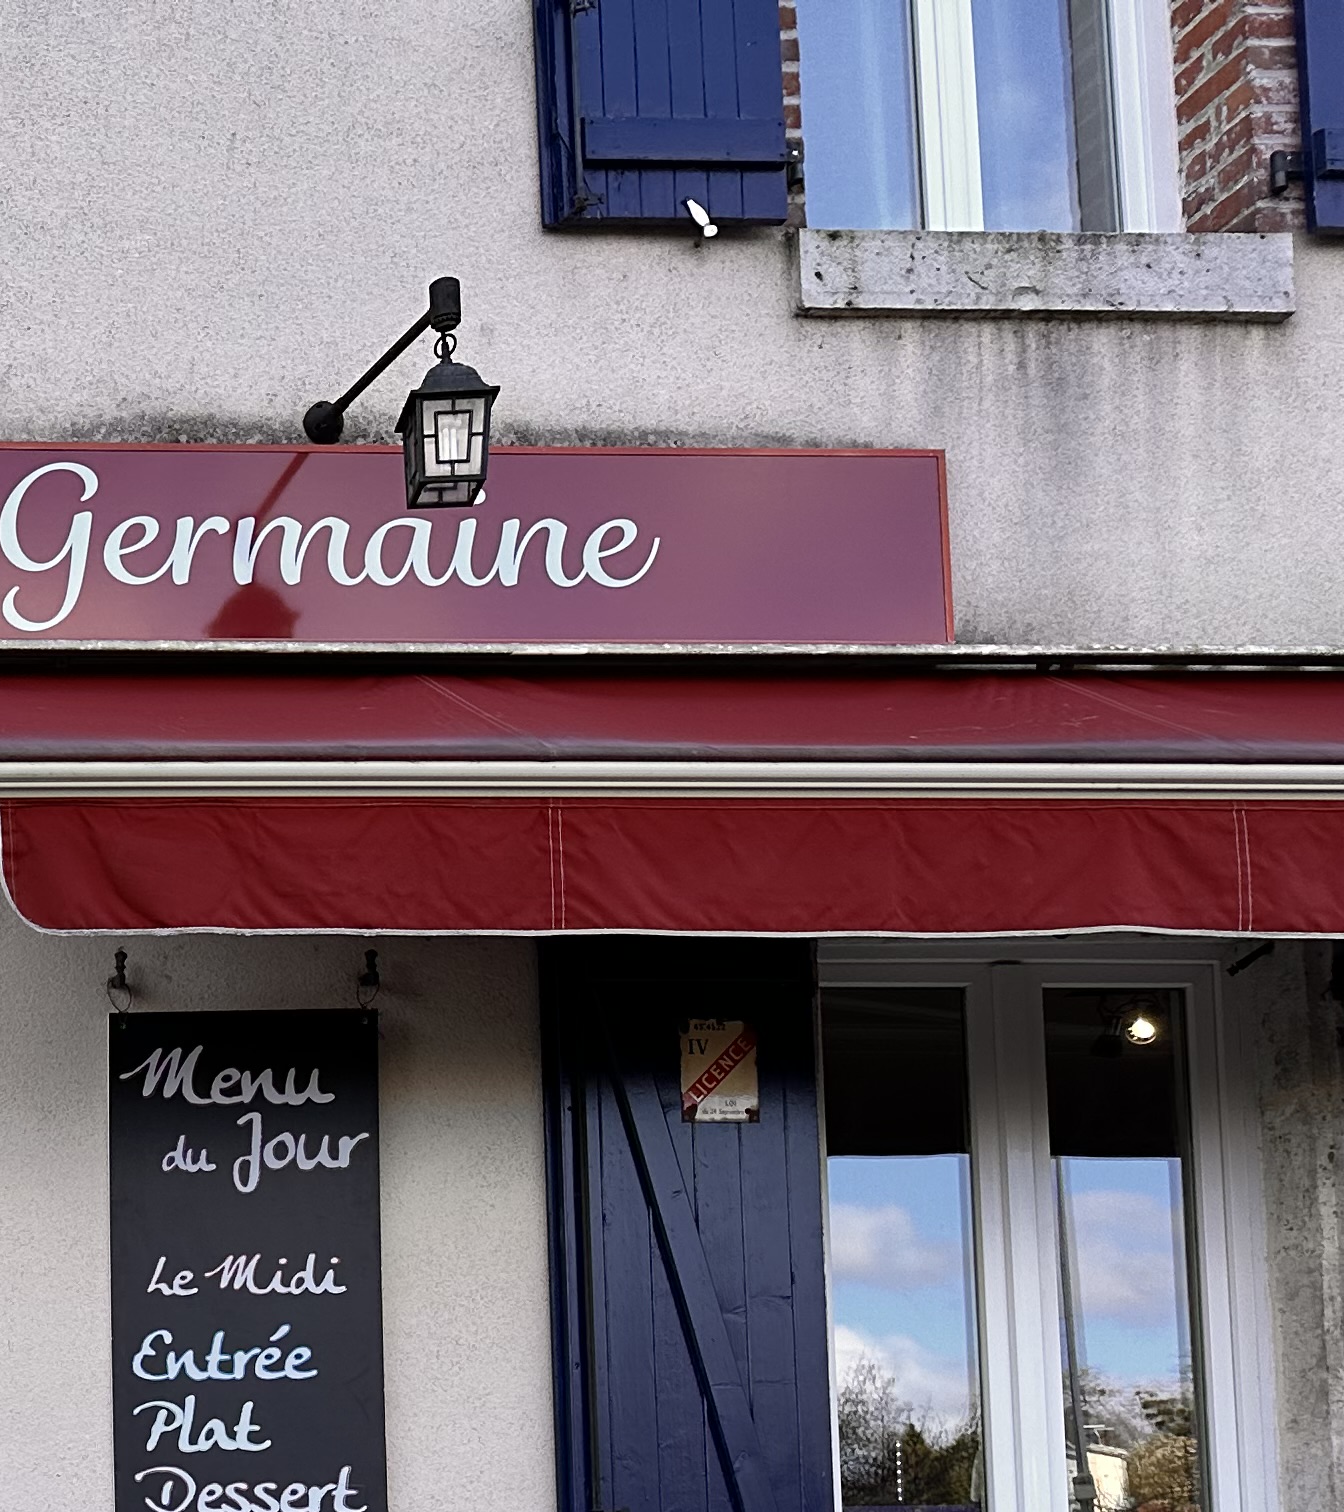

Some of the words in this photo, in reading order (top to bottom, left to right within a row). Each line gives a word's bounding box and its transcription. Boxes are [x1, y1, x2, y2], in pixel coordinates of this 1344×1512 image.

[119, 1045, 336, 1105] Menu
[688, 1039, 709, 1055] IV
[688, 1036, 752, 1102] LICENCE
[162, 1134, 216, 1172] du
[232, 1111, 369, 1193] Jour
[147, 1256, 200, 1296] Le
[204, 1252, 347, 1295] Midi
[132, 1324, 318, 1381] Entrée
[132, 1395, 272, 1453] Plat
